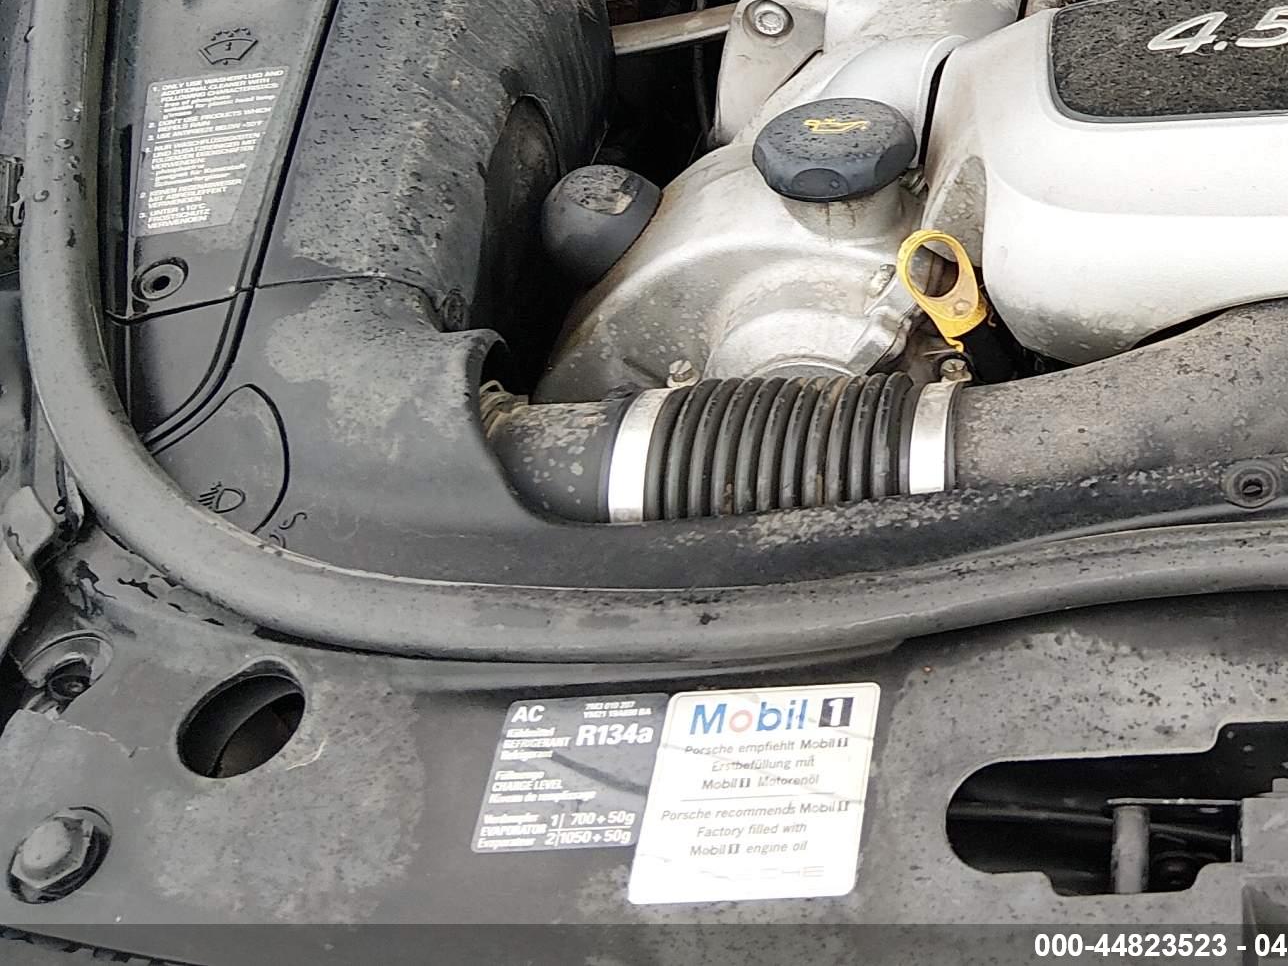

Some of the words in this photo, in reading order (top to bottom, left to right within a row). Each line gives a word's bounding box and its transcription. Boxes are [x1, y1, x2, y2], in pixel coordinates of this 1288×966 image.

[511, 705, 545, 723] AC
[689, 699, 808, 735] Mobil
[576, 723, 653, 746] R134a
[684, 745, 733, 755] Porsche
[739, 741, 795, 755] empfiehlt
[800, 739, 835, 749] Mobil
[795, 755, 815, 767] mit
[534, 779, 563, 790] LEVEL
[702, 779, 738, 790] Mobil
[551, 814, 559, 826] 1
[570, 813, 595, 825] 700
[608, 811, 635, 827] 50g
[660, 809, 711, 821] Porsche
[715, 801, 796, 818] recommends
[800, 801, 835, 814] Mobil
[544, 832, 556, 846] 2
[560, 831, 592, 843] 1050
[604, 830, 632, 844] 50g
[697, 826, 744, 838] Factory
[748, 824, 779, 834] filled
[783, 823, 808, 834] with
[690, 844, 726, 856] Mobil
[746, 841, 788, 855] engine
[793, 840, 808, 851] oil
